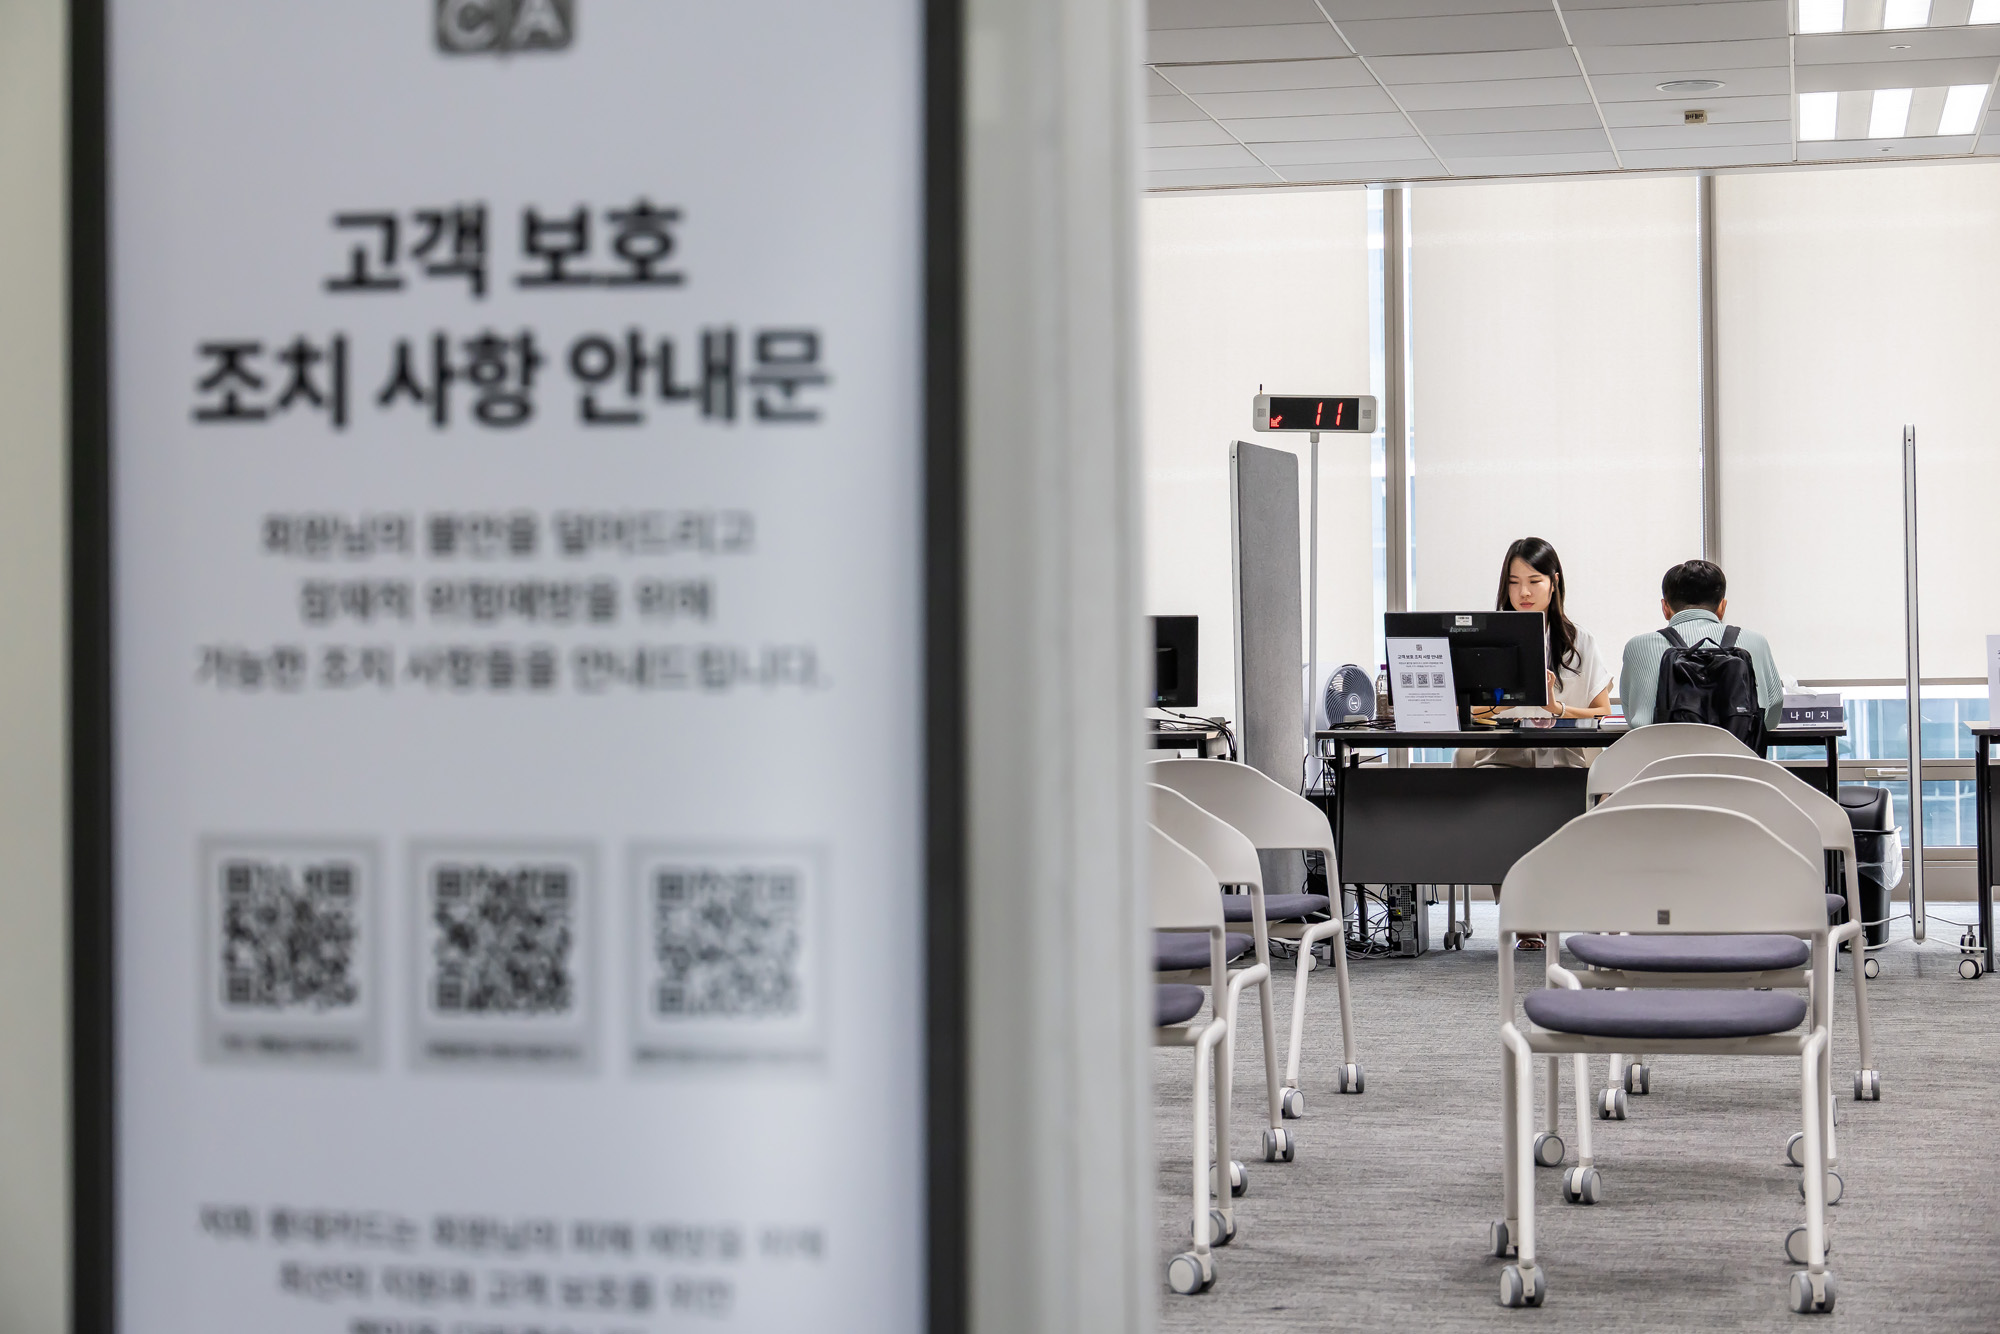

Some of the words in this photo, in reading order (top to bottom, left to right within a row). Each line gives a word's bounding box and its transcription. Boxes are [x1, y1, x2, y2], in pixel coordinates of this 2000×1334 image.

[325, 203, 489, 300] 고객
[515, 200, 686, 289] 보호
[192, 335, 350, 429] 조치
[377, 333, 545, 428] 사항
[567, 328, 830, 426] 안내문
[1315, 401, 1344, 426] 11
